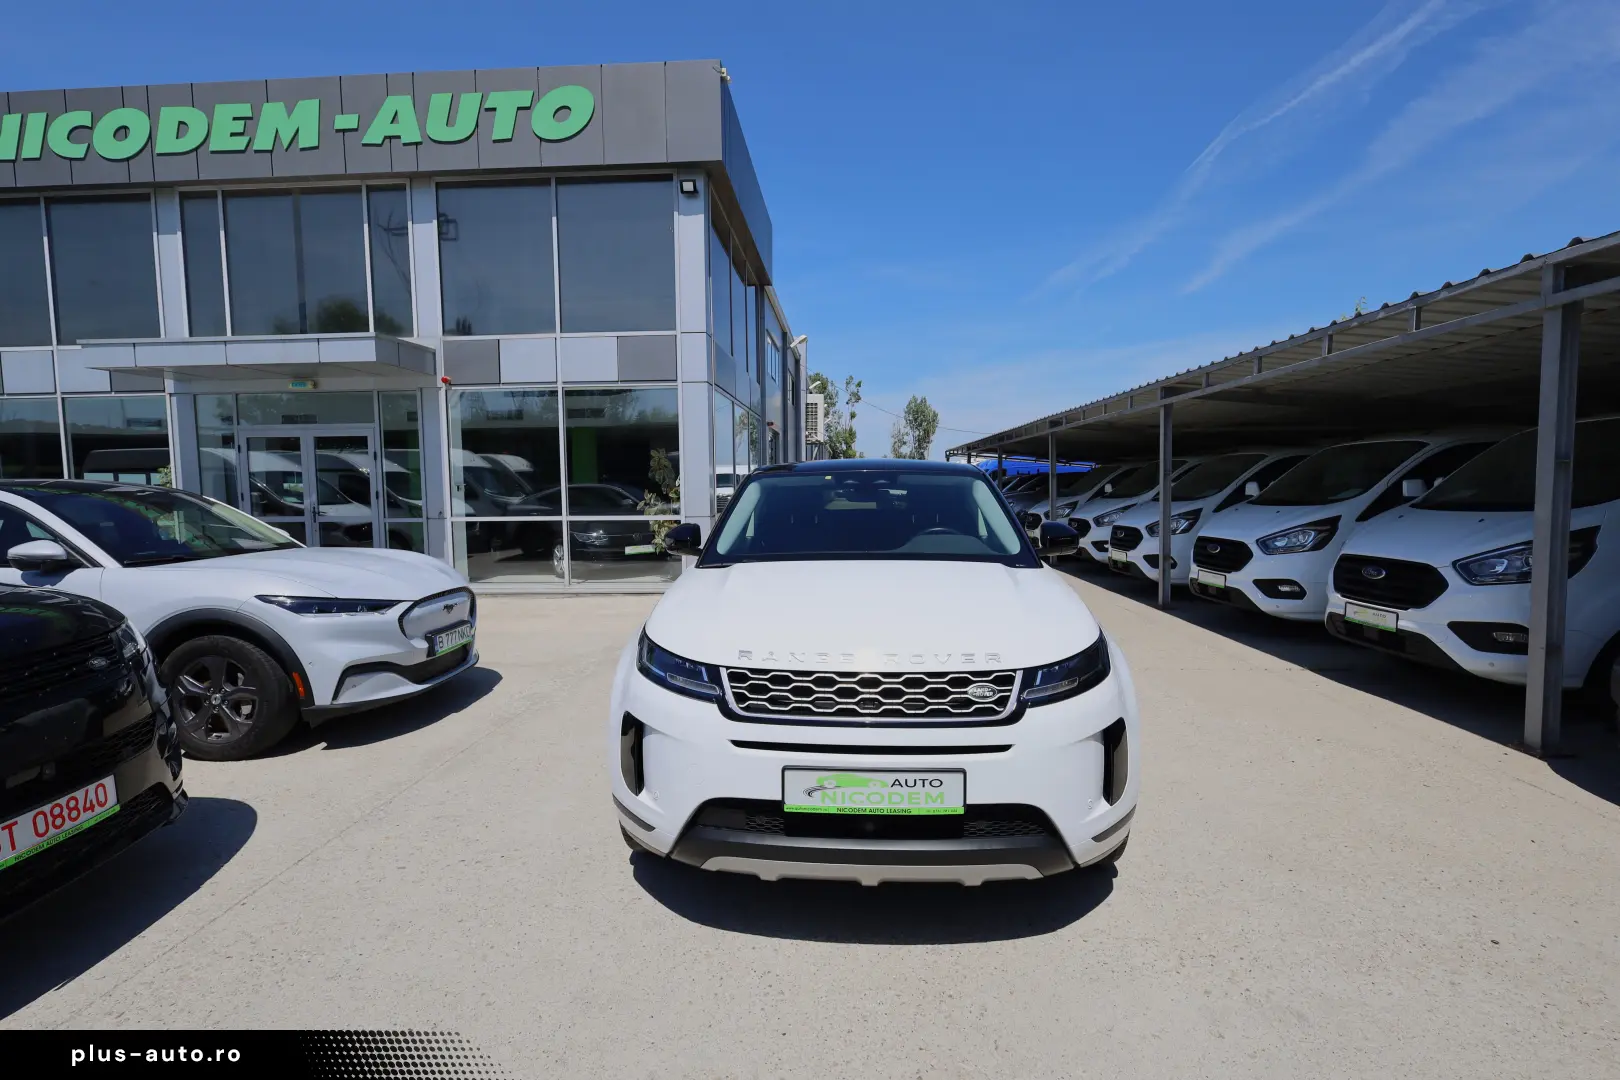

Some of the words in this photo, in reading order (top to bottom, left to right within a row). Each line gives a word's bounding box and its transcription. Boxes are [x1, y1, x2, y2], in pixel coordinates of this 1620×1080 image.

[438, 636, 444, 649] B
[883, 652, 1002, 664] ROVER
[890, 778, 943, 788] AUTO
[819, 791, 945, 805] NICODEM
[0, 820, 18, 853] T
[32, 783, 107, 838] 08840
[14, 842, 45, 861] NICODEM
[46, 835, 61, 847] AUTO
[62, 825, 83, 839] LEASING
